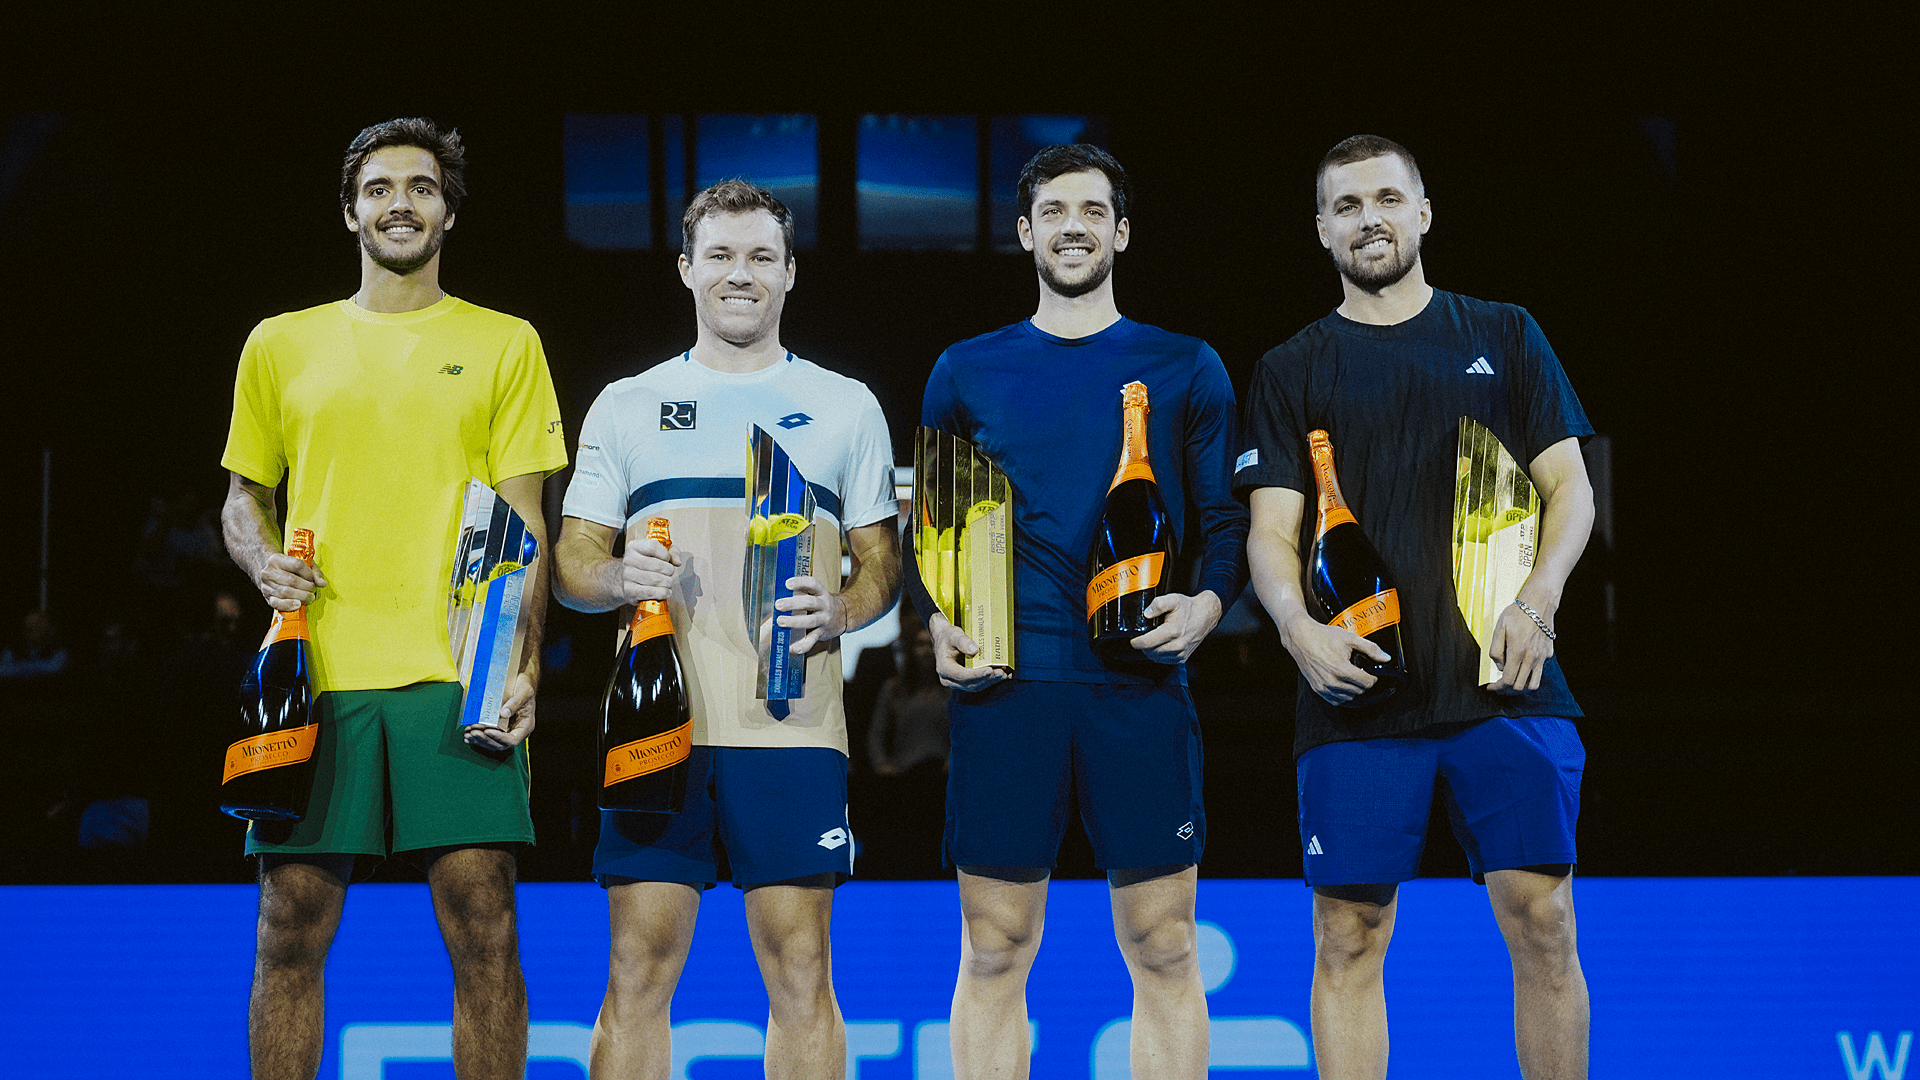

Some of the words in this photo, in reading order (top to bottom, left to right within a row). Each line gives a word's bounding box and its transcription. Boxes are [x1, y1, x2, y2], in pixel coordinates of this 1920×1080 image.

[996, 532, 1005, 554] OPEN
[1523, 544, 1533, 568] OPEN
[1092, 565, 1139, 594] MIONETTO
[242, 737, 297, 758] MIONETTO
[629, 736, 681, 762] MIONETTO
